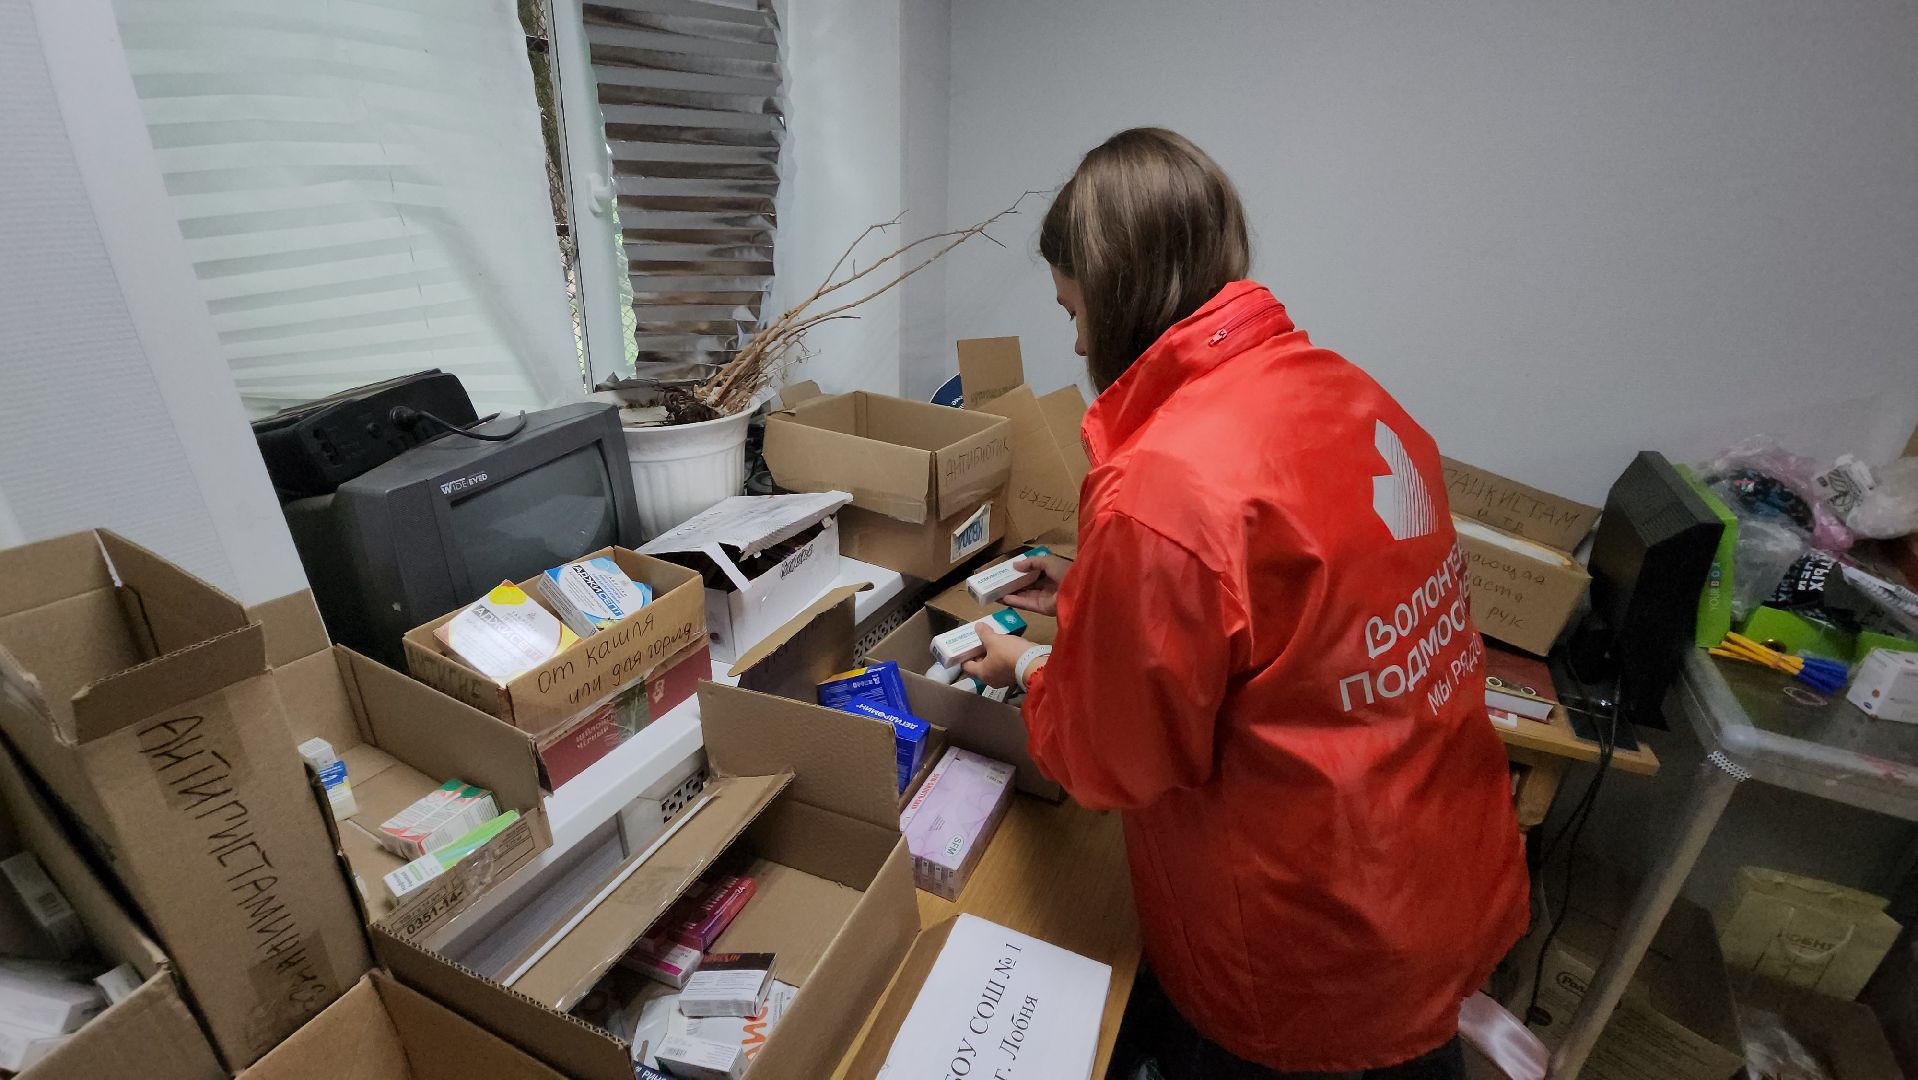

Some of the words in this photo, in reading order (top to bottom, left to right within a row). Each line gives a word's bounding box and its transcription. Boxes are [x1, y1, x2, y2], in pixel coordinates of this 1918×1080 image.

[440, 477, 467, 495] WIDE
[468, 473, 488, 486] EYED
[572, 564, 624, 617] АДЖИСЕПТ
[568, 679, 602, 705] или
[612, 650, 642, 687] для
[1427, 678, 1452, 716] МЫ
[947, 836, 962, 856] SFM
[1005, 943, 1022, 953] 1
[994, 957, 1017, 980] №
[969, 978, 1006, 1035] СОШ
[999, 994, 1039, 1061] Лобня
